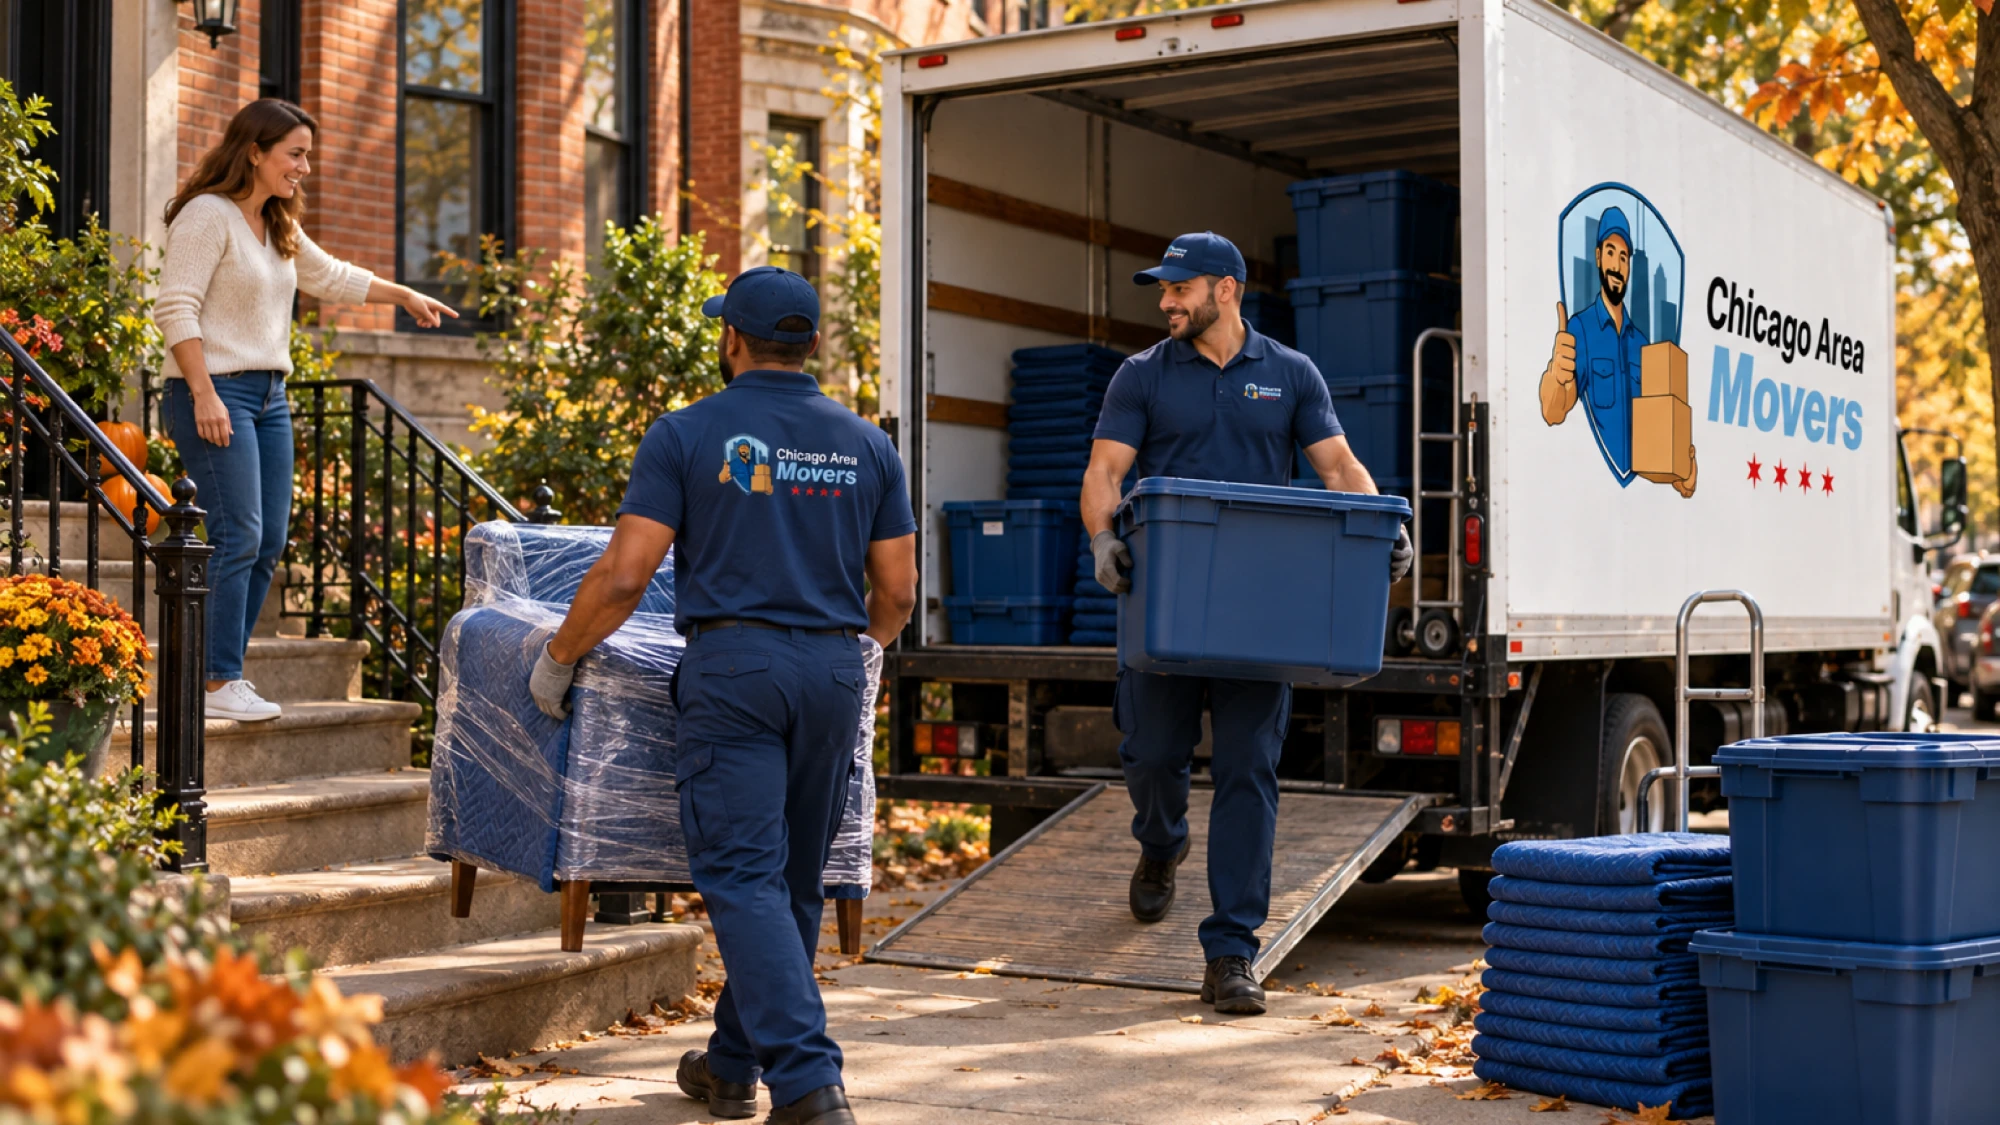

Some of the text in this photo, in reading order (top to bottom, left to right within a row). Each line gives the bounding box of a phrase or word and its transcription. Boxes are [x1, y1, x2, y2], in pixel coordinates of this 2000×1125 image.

[1707, 276, 1865, 374] Chicago Area
[1708, 344, 1863, 451] Movers
[776, 448, 857, 466] Chicago Area
[776, 461, 857, 485] Movers
